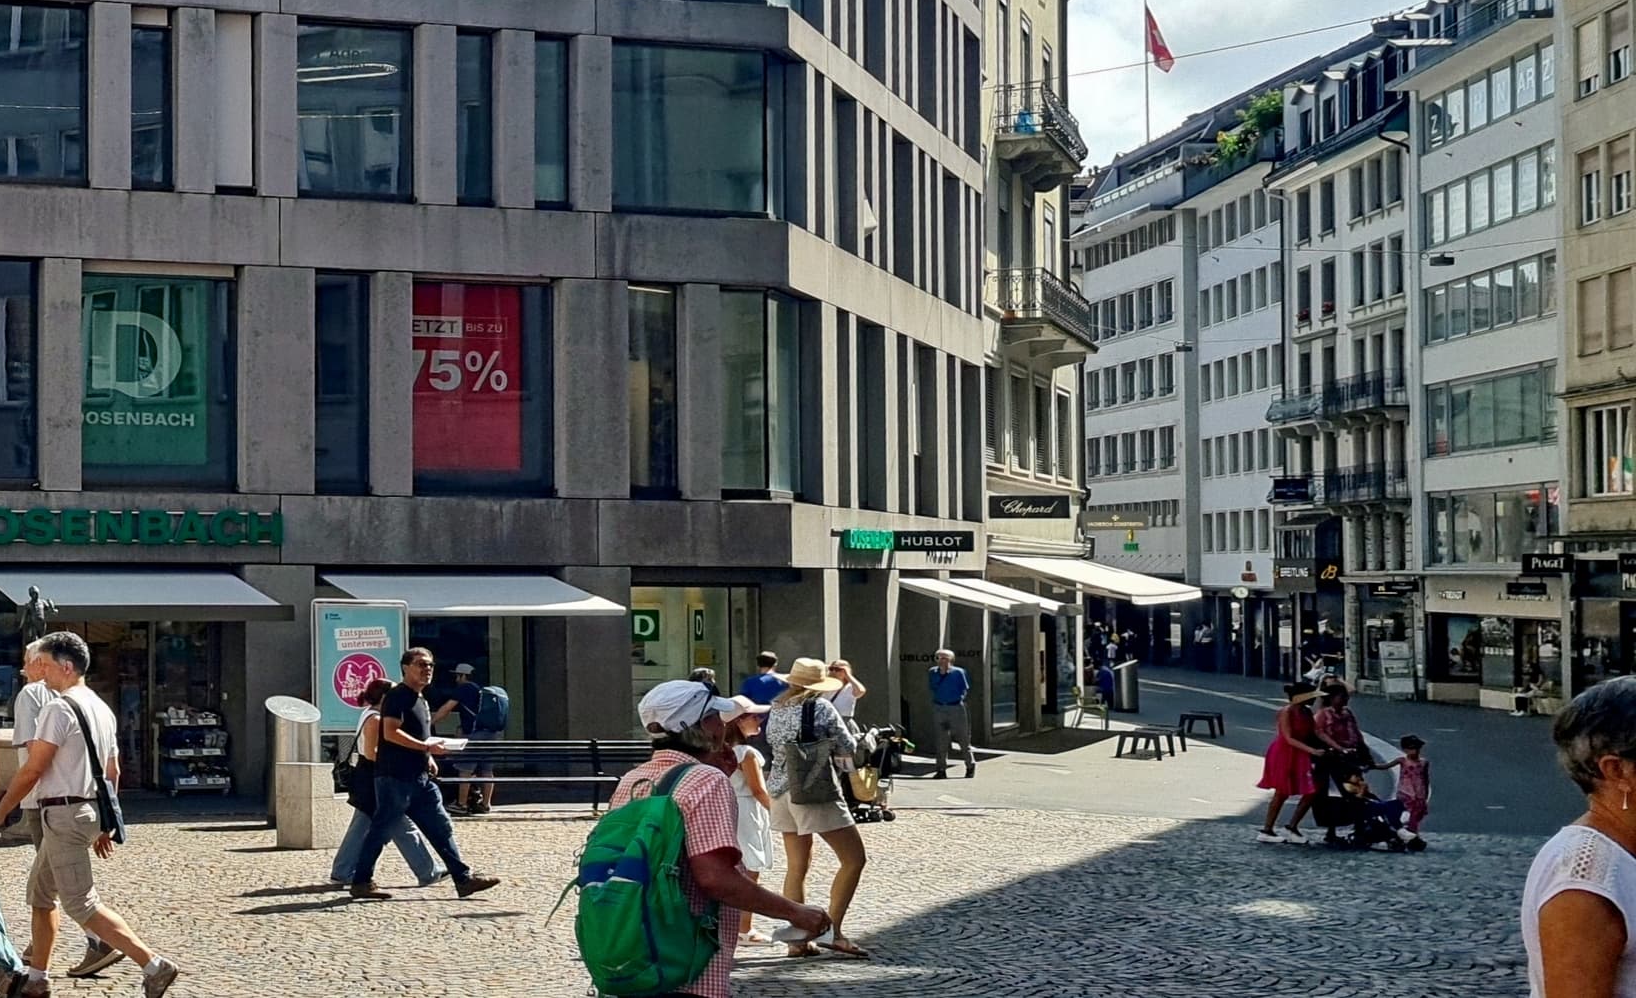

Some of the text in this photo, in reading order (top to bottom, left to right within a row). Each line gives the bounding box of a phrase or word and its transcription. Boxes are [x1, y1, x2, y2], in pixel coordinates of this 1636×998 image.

[412, 319, 503, 334] ETZT BIS ZU
[91, 310, 183, 399] D
[81, 410, 196, 428] OSENBACH
[999, 499, 1059, 517] Chopard
[900, 536, 964, 547] HUBLOT
[1531, 557, 1565, 570] PIAGET
[633, 614, 656, 637] D
[338, 628, 384, 639] Entspannt
[341, 639, 388, 649] unterwegs
